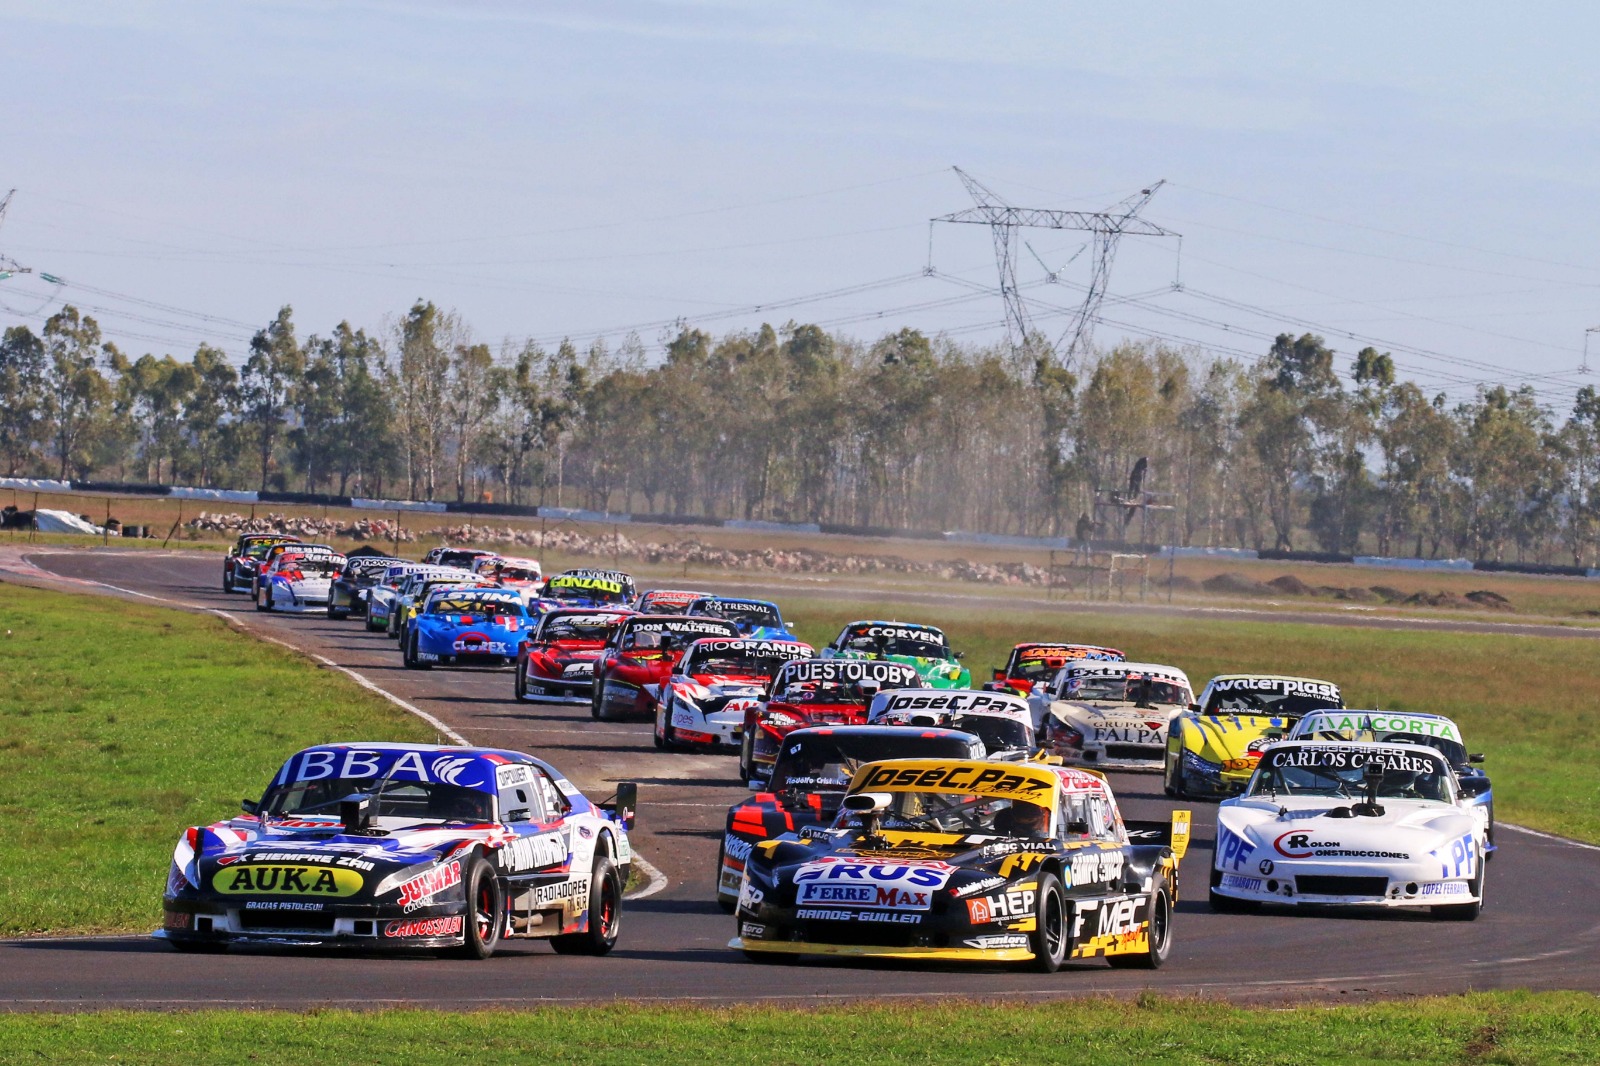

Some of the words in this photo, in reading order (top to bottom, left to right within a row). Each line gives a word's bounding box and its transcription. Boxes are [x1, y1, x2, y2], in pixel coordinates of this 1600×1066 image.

[550, 576, 622, 594] GONZALO
[723, 603, 770, 614] TRESNAL
[632, 624, 663, 633] DON
[665, 622, 732, 637] WALTHER
[868, 627, 944, 646] CORVEN
[1214, 678, 1341, 699] waterplast
[1093, 721, 1143, 730] GRUPO
[1273, 752, 1346, 767] CARLOS
[1300, 745, 1406, 757] FRIGORIFICO
[296, 750, 430, 782] BBA
[253, 852, 335, 864] SIEMPRE
[229, 867, 339, 893] AUKA
[397, 860, 462, 907] JULMAR
[827, 864, 947, 887] RUS
[536, 879, 588, 901] RADIADORES
[1422, 883, 1443, 895] LOPEZ
[246, 901, 278, 910] GRACIAS
[986, 890, 1035, 917] HEP
[796, 908, 922, 924] RAMOS-GUILLEN
